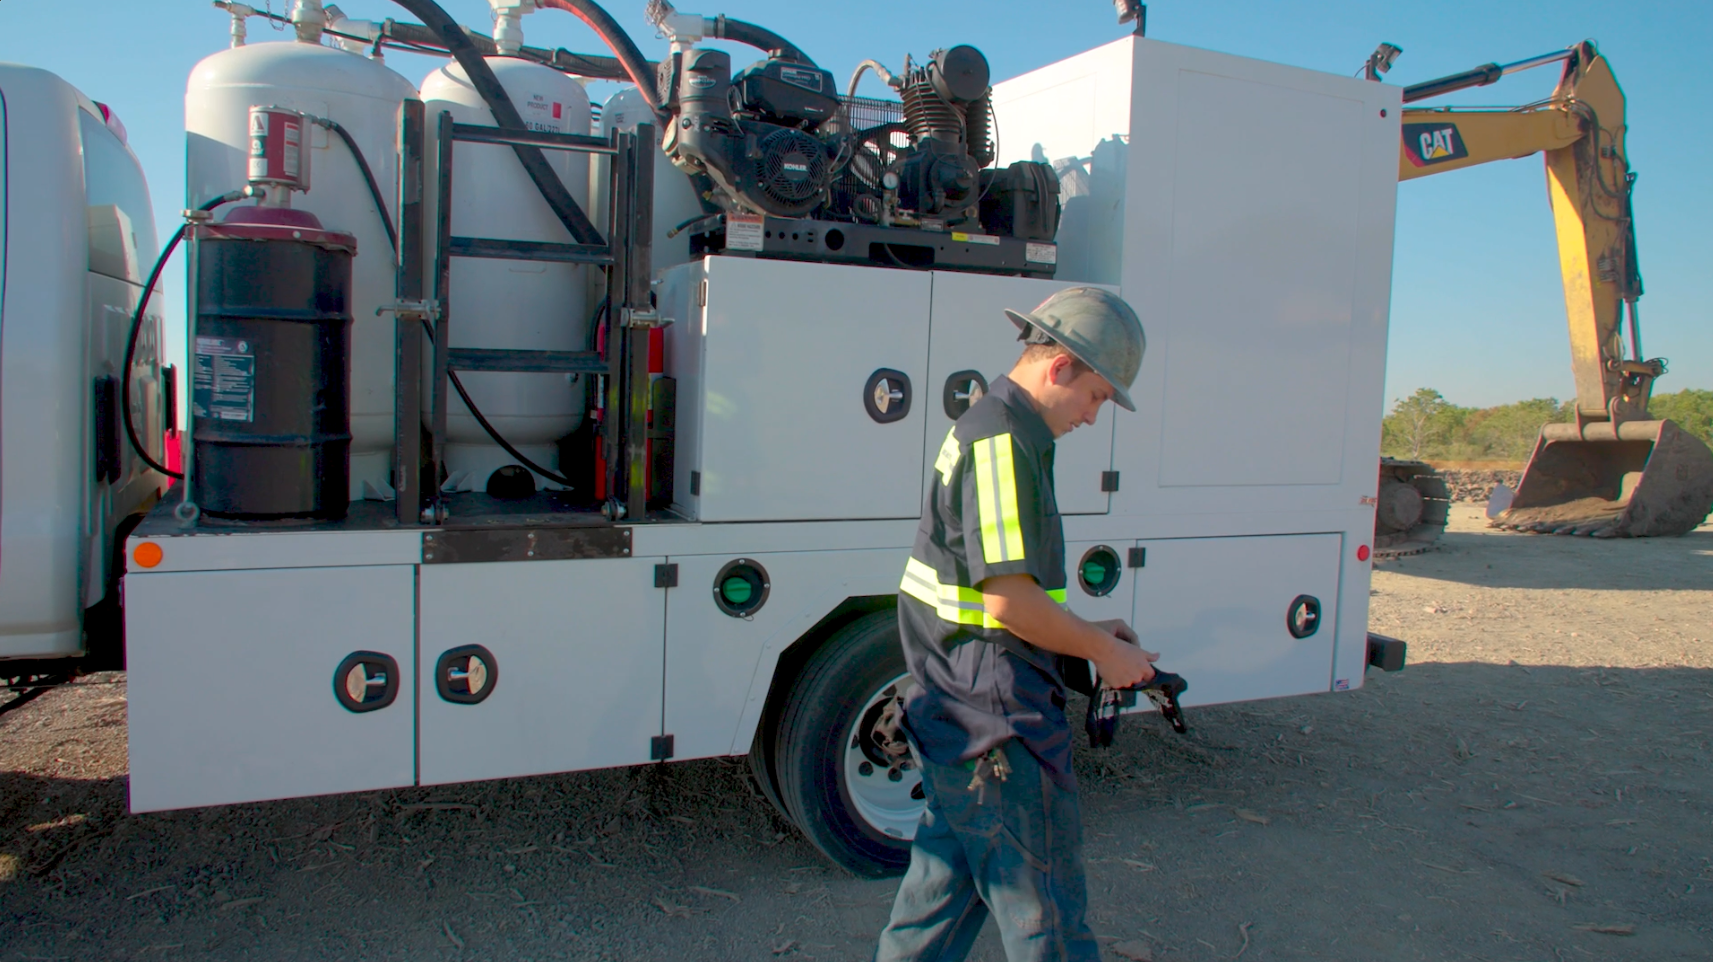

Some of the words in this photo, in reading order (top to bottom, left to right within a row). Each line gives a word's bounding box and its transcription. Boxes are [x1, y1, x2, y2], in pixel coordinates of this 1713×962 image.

[527, 101, 548, 110] PRODUCT
[1420, 128, 1453, 159] CAT
[783, 162, 807, 171] KOHLER
